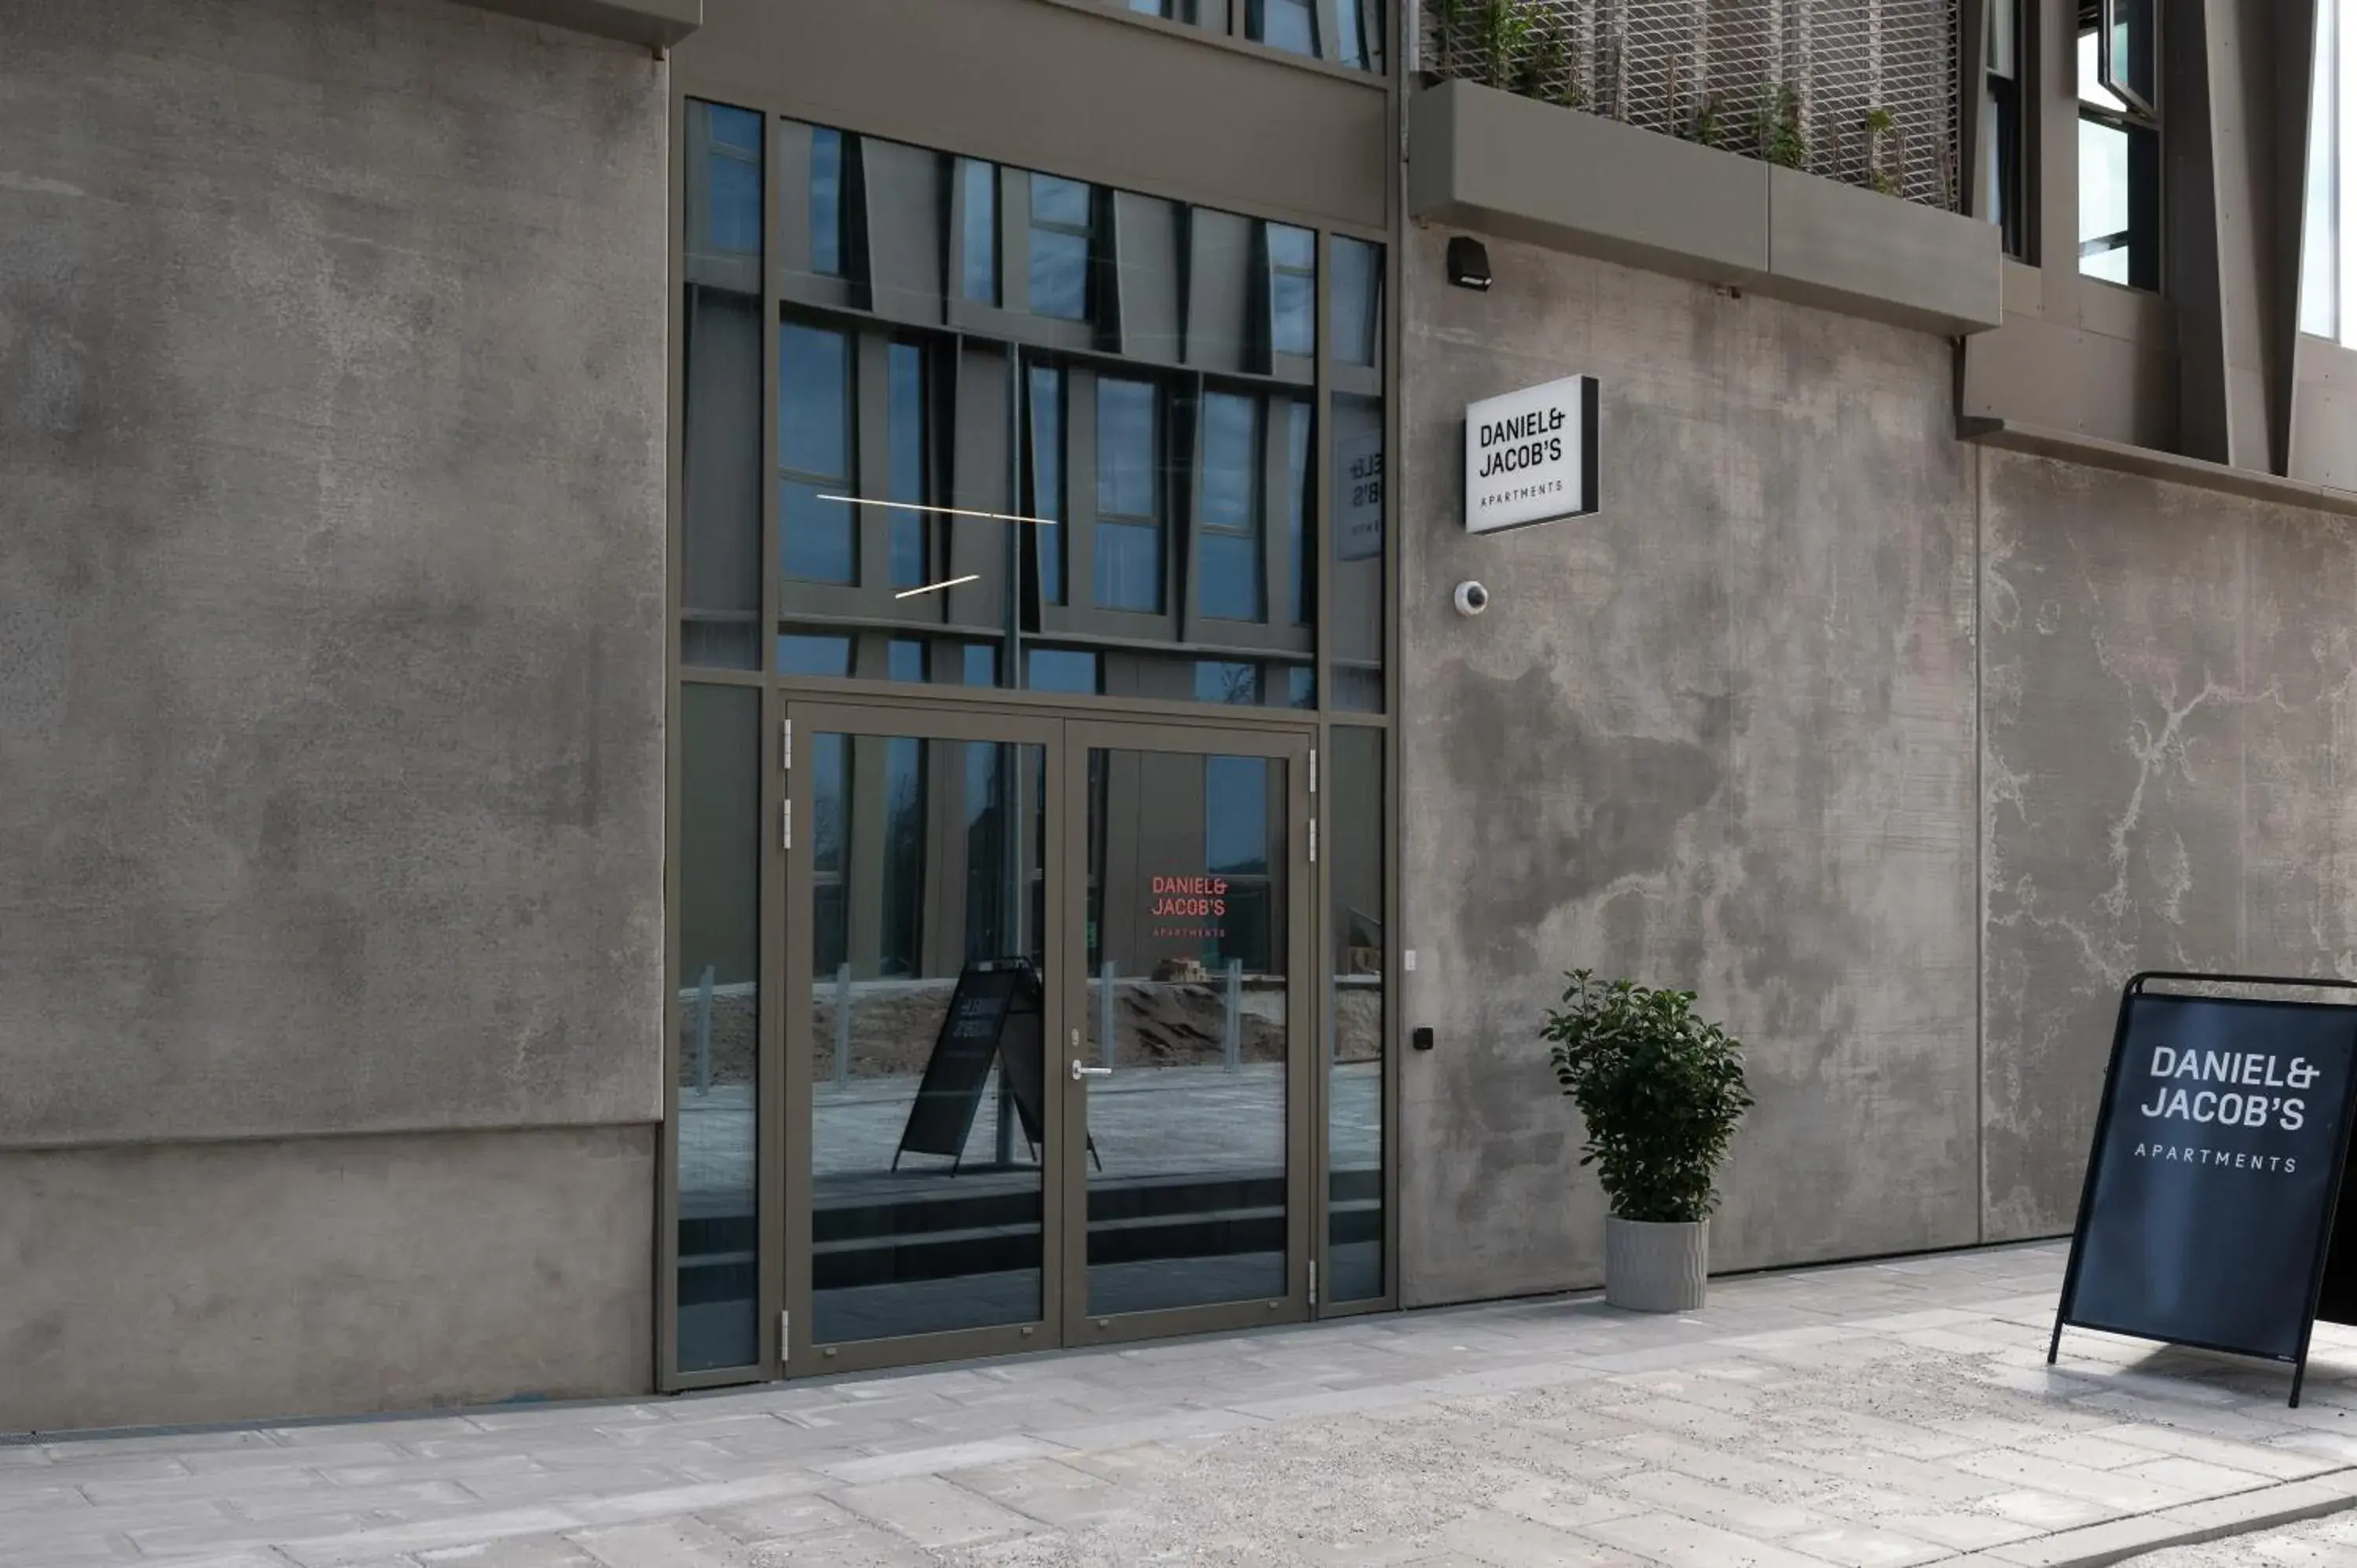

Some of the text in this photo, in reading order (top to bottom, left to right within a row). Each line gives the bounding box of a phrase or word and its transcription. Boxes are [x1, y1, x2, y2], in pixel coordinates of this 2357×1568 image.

[1481, 407, 1565, 448] DANIEL&
[1479, 438, 1561, 478] JACOB'S
[1481, 480, 1563, 507] APARTMENTS
[1153, 877, 1228, 895] DANIEL&
[1152, 898, 1226, 916] JACOB'S
[2150, 1046, 2320, 1090] DANIEL&
[2141, 1087, 2305, 1130] JACOB'S
[2135, 1143, 2297, 1173] APARTMENTS
